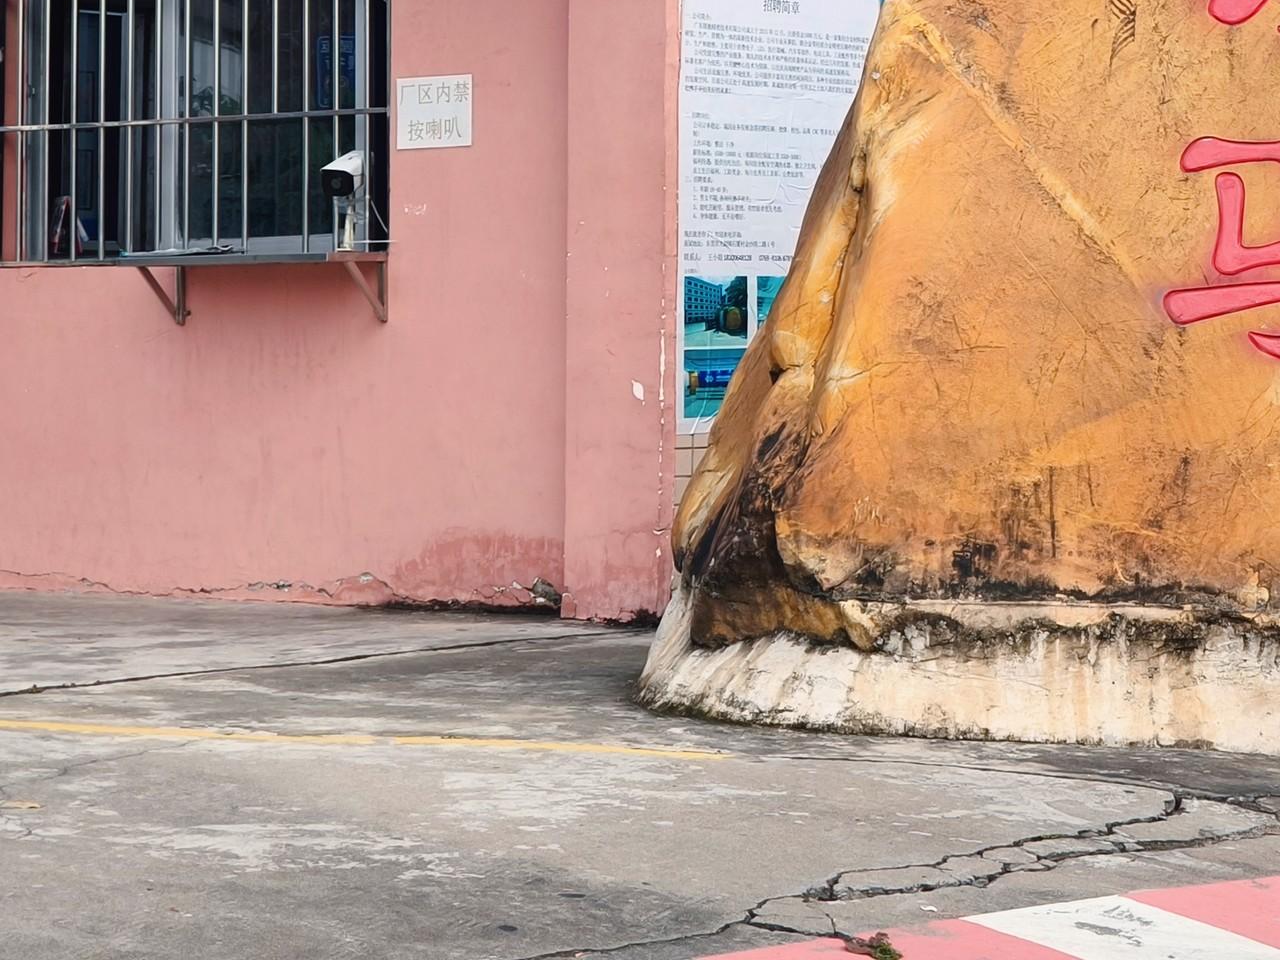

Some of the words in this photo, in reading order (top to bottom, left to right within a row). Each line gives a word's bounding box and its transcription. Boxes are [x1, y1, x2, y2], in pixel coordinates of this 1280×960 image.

[763, 0, 801, 15] 招聘简章
[400, 81, 470, 105] 厂区内禁
[408, 114, 462, 141] 按喇叭
